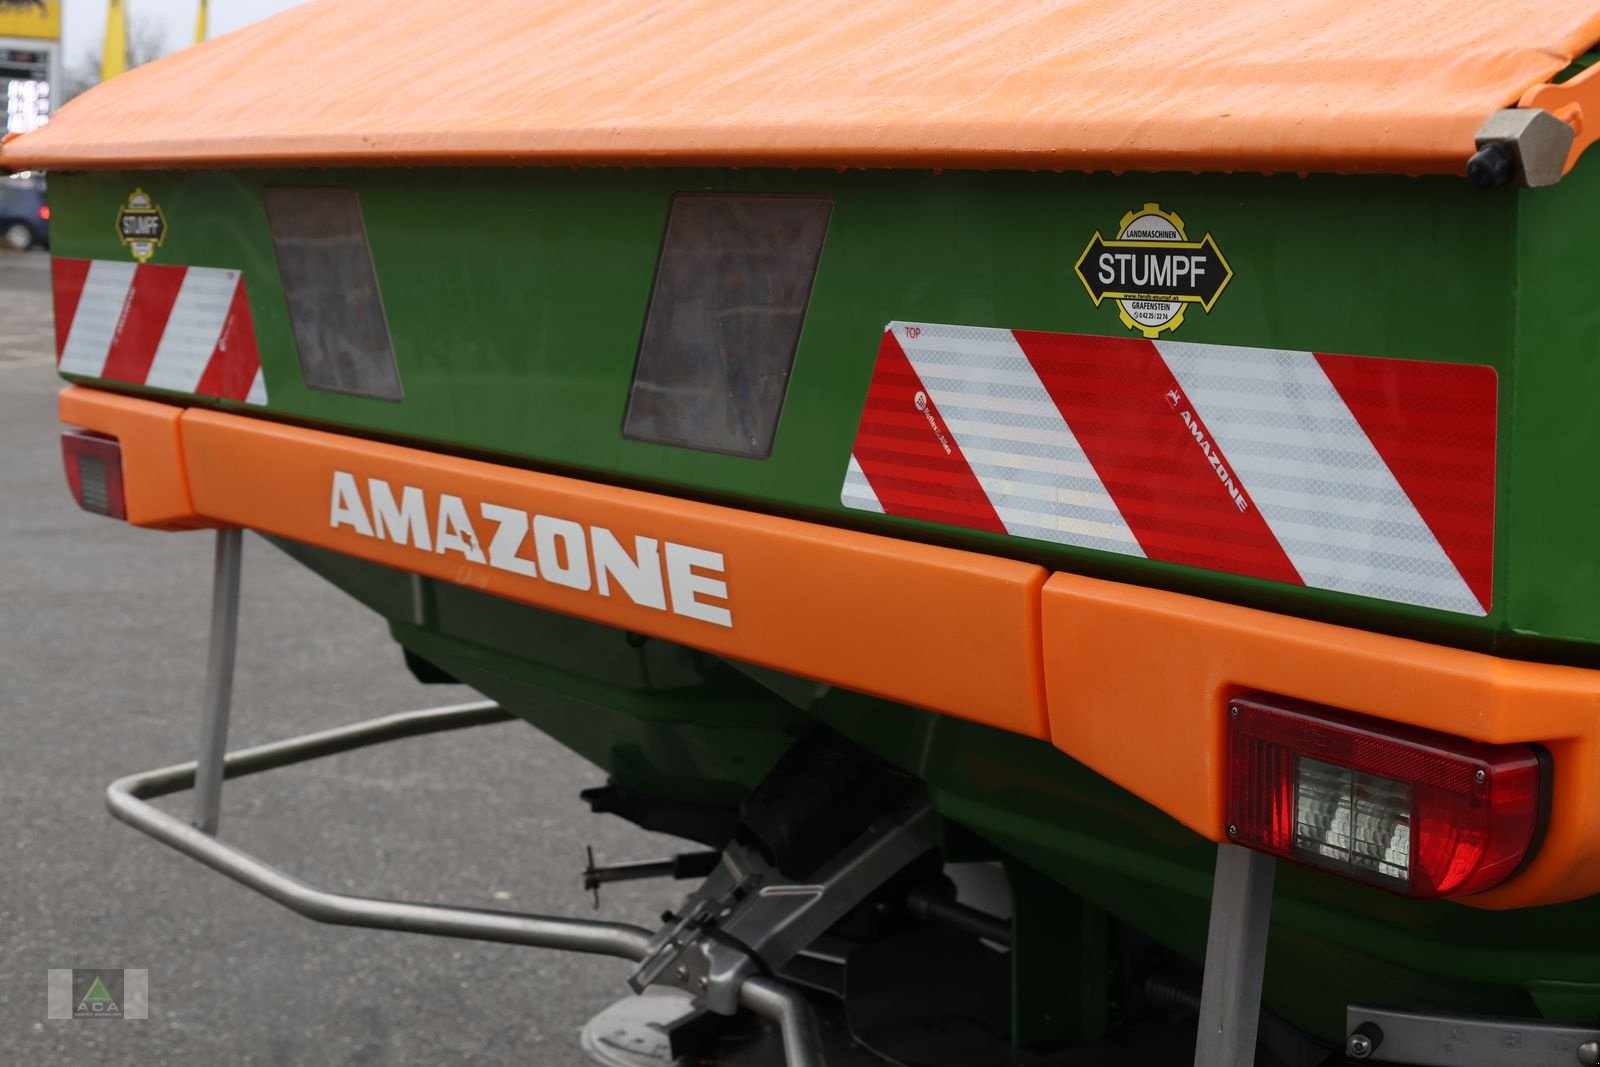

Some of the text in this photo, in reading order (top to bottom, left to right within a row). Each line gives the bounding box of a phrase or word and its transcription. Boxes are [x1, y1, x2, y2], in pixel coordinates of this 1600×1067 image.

[122, 215, 159, 235] STUMPF
[1126, 230, 1177, 239] LANDMASCHINEN
[1098, 253, 1207, 288] STUMPF
[1131, 301, 1171, 311] GRAFENSTEIN
[905, 326, 921, 339] TOP
[1179, 409, 1247, 513] AMAZONE
[329, 470, 733, 628] AMAZONE
